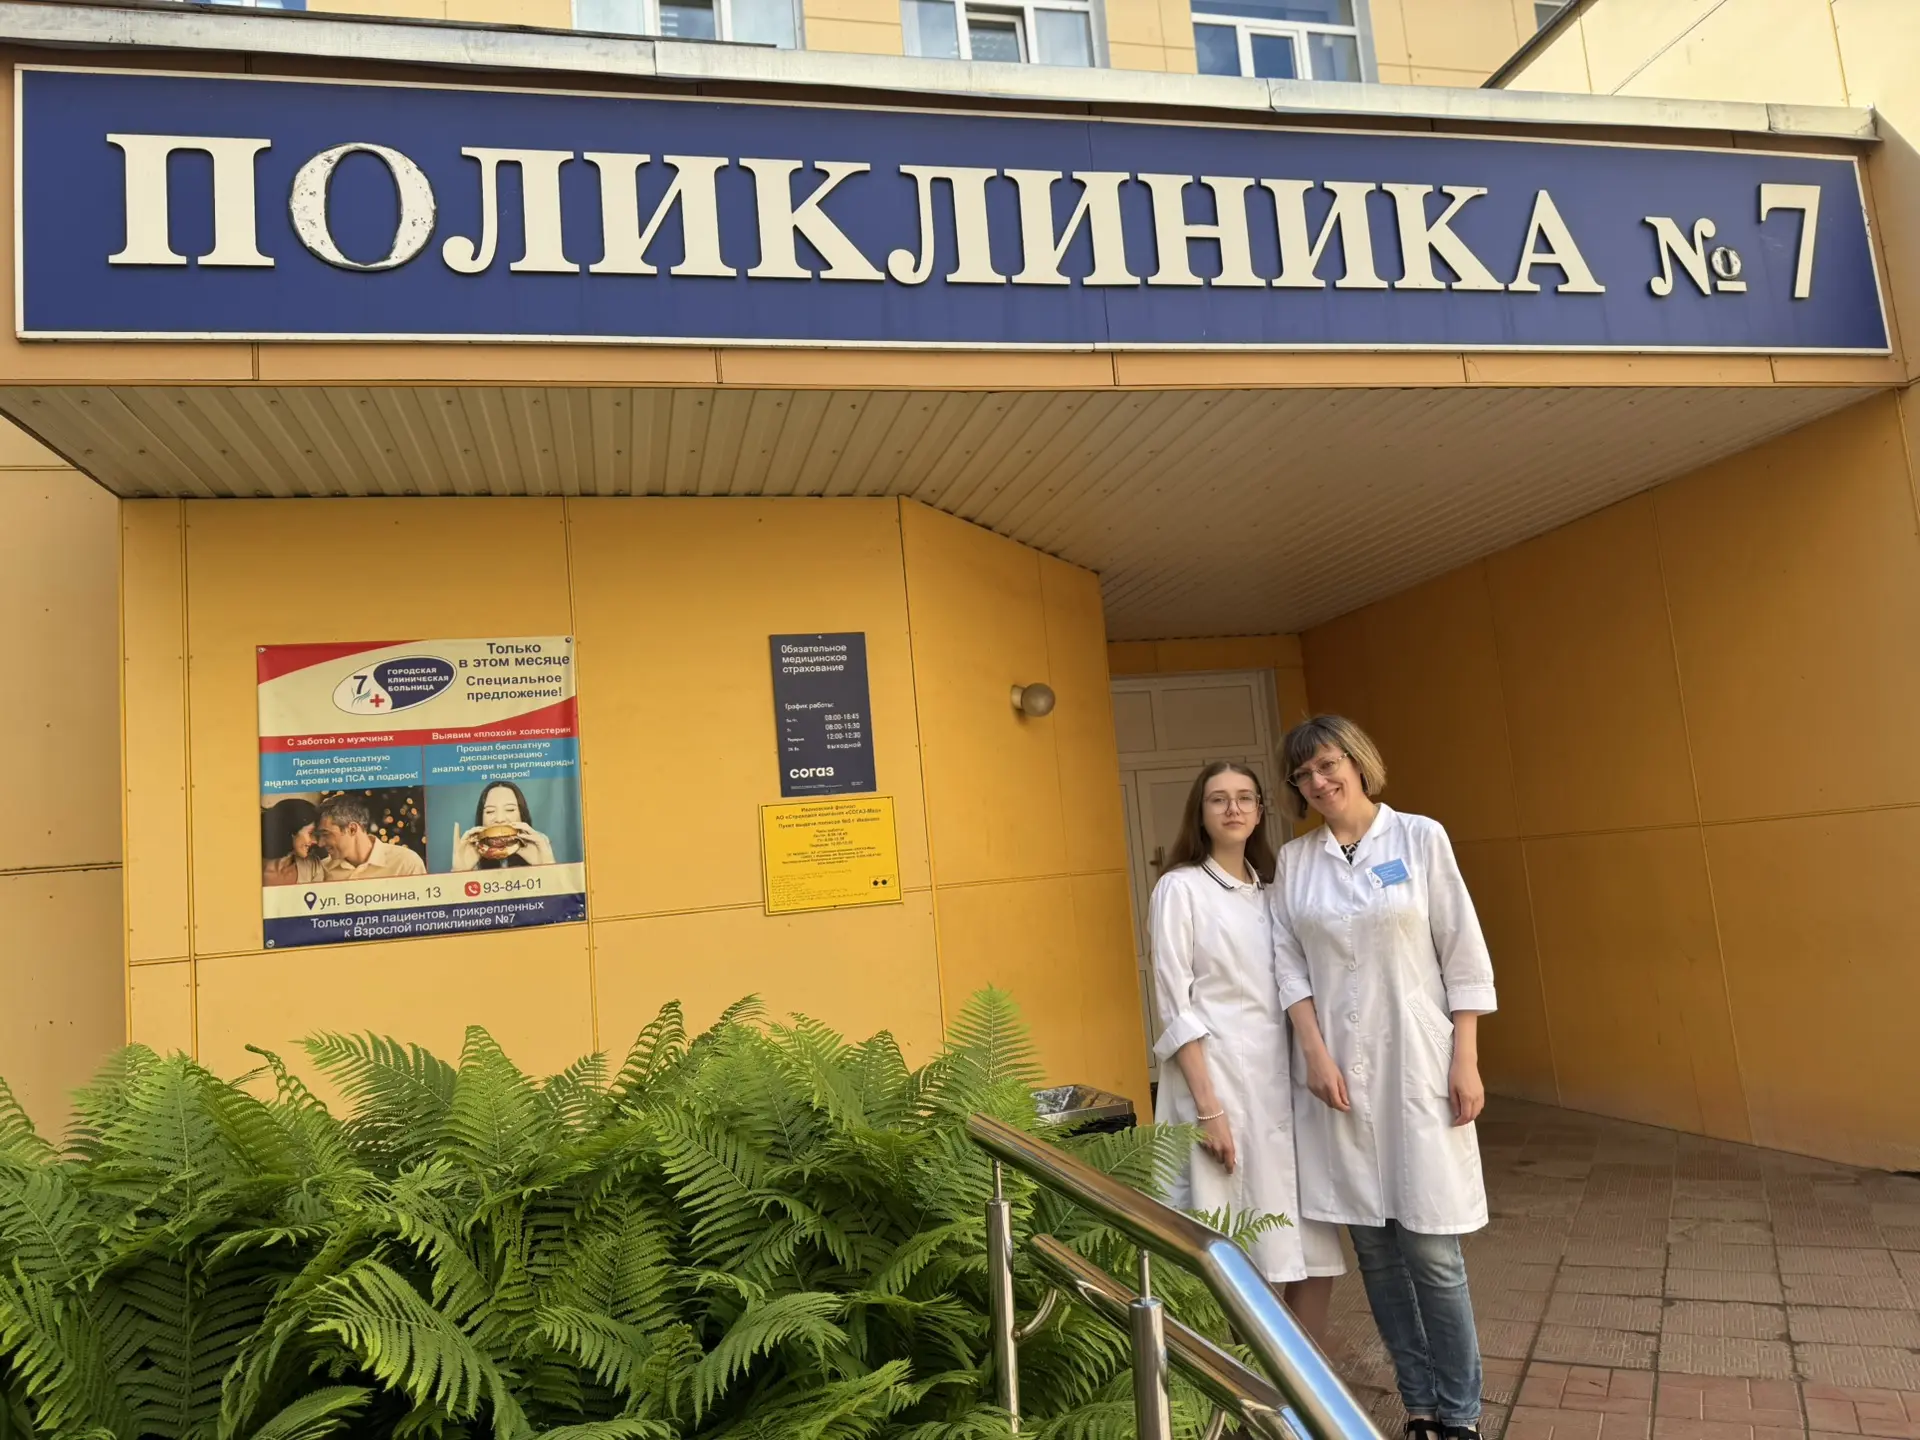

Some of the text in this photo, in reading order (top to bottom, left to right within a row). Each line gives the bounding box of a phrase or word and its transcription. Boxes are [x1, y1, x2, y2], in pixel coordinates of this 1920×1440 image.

[106, 133, 1821, 298] ПОЛИКЛИНИКА № 7
[486, 642, 541, 655] Только
[781, 644, 847, 654] Обязательное
[458, 655, 570, 668] в этом месяце
[782, 654, 848, 664] медицинское
[387, 667, 437, 675] ГОРОДСКАЯ
[782, 664, 845, 675] страхование
[353, 675, 368, 695] 7
[387, 675, 449, 684] КЛИНИЧЕСКАЯ
[466, 674, 562, 688] Специальное
[388, 684, 434, 692] БОЛЬНИЦА
[467, 688, 562, 702] предложение!
[785, 702, 808, 711] График
[432, 726, 571, 740] Выявим «плохой» холестерин
[287, 738, 294, 746] С
[297, 737, 336, 746] заботой
[347, 734, 394, 745] мужчинах
[826, 741, 862, 750] выходной
[456, 741, 550, 753] Прошел бесплатную
[292, 754, 391, 767] Прошел бесплатную
[459, 751, 543, 763] диспансеризацию
[295, 764, 382, 776] диспансеризацию
[432, 758, 574, 774] анализ крови на триглицериды
[789, 766, 834, 779] согаз
[264, 779, 298, 788] анализ
[301, 778, 329, 786] крови
[332, 776, 343, 784] на
[345, 774, 366, 783] ПСА
[376, 771, 419, 781] подарок!
[489, 770, 530, 780] подарок!
[483, 878, 542, 894] 93-84-01
[319, 886, 441, 910] ул. Воронина, 13
[310, 901, 545, 930] Только для пациентов, прикрепленных
[344, 912, 516, 939] к Взрослой поликлинике №7
